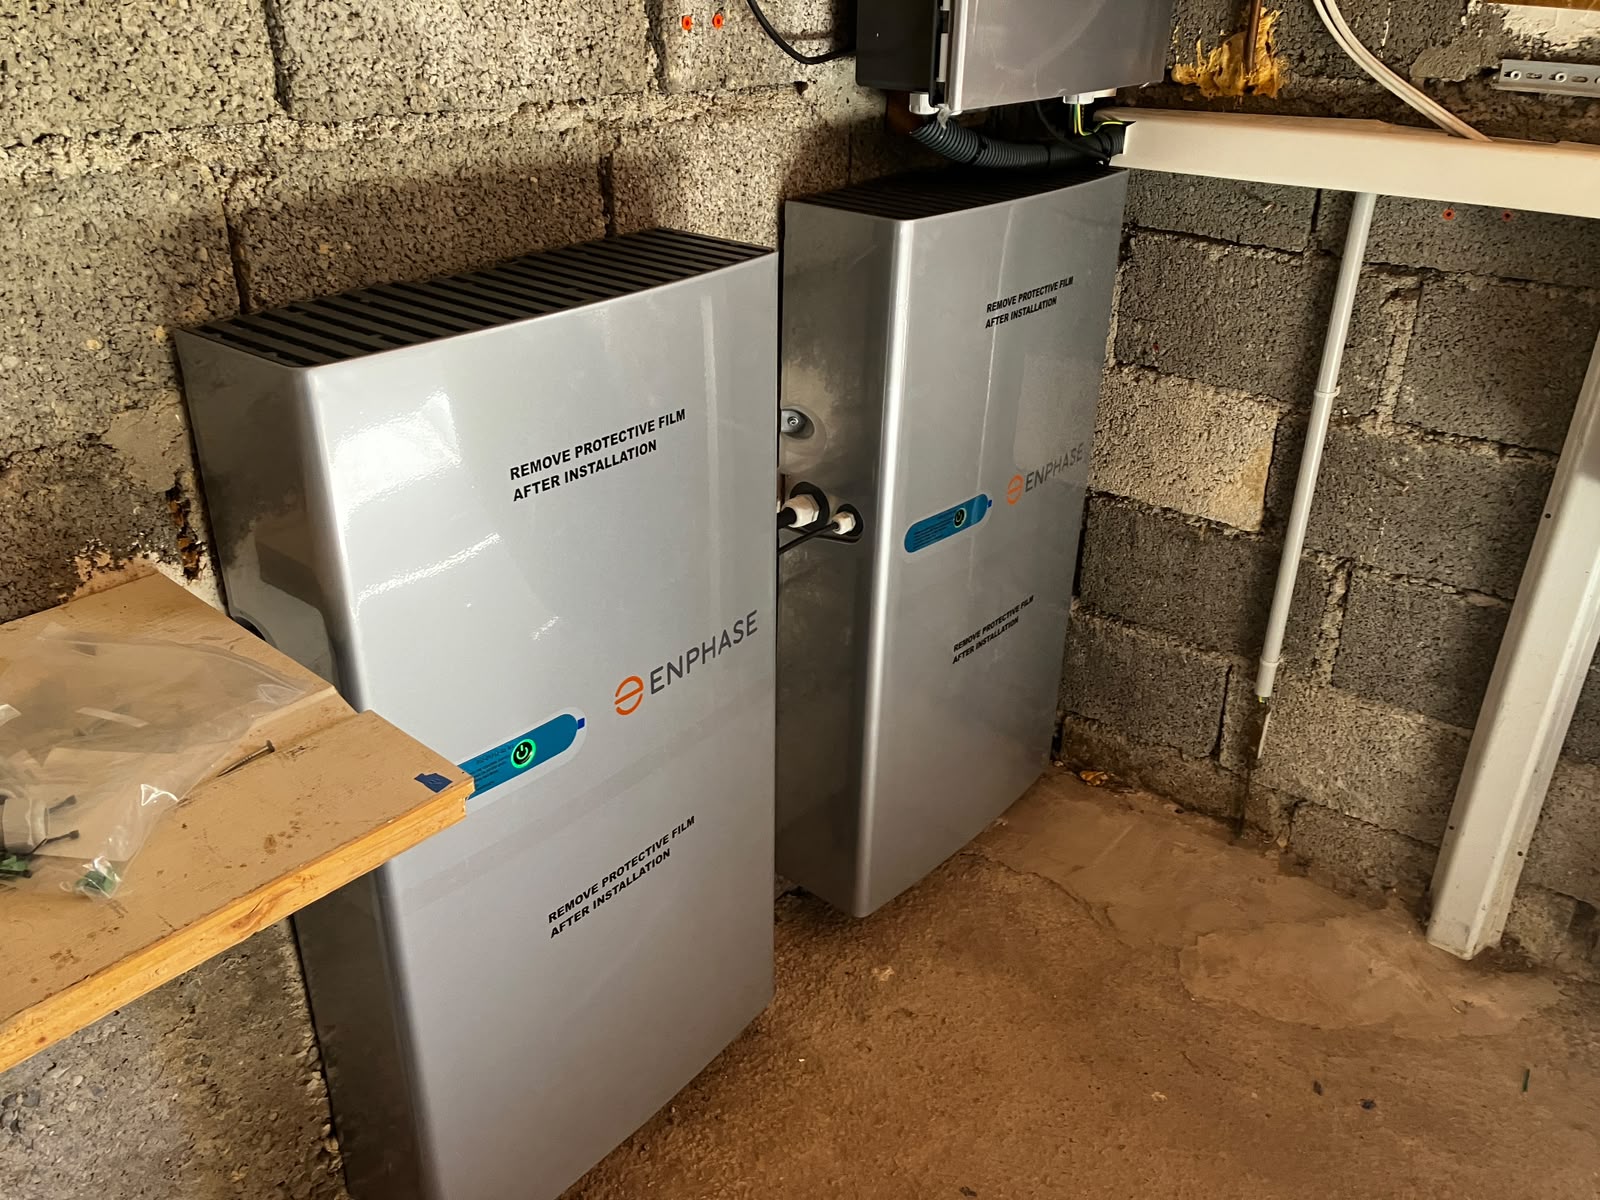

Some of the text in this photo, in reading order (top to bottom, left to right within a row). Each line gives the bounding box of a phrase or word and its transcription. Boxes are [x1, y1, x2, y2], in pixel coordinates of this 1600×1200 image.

[985, 296, 1057, 328] AFTER INSTALLATION
[986, 276, 1074, 313] REMOVE PROTECTIVE FILM
[510, 409, 686, 480] REMOVE PROTECTIVE FILM
[513, 439, 657, 501] AFTER INSTALLATION
[1025, 442, 1084, 492] ENPHASE
[650, 609, 759, 695] ENPHASE
[952, 616, 1019, 665] AFTER INSTALLATION
[953, 629, 981, 652] REMOVE
[982, 604, 1020, 635] PROTECTIVE
[548, 816, 695, 924] REMOVE PROTECTIVE FILM
[550, 848, 671, 939] AFTER INSTALLATION
